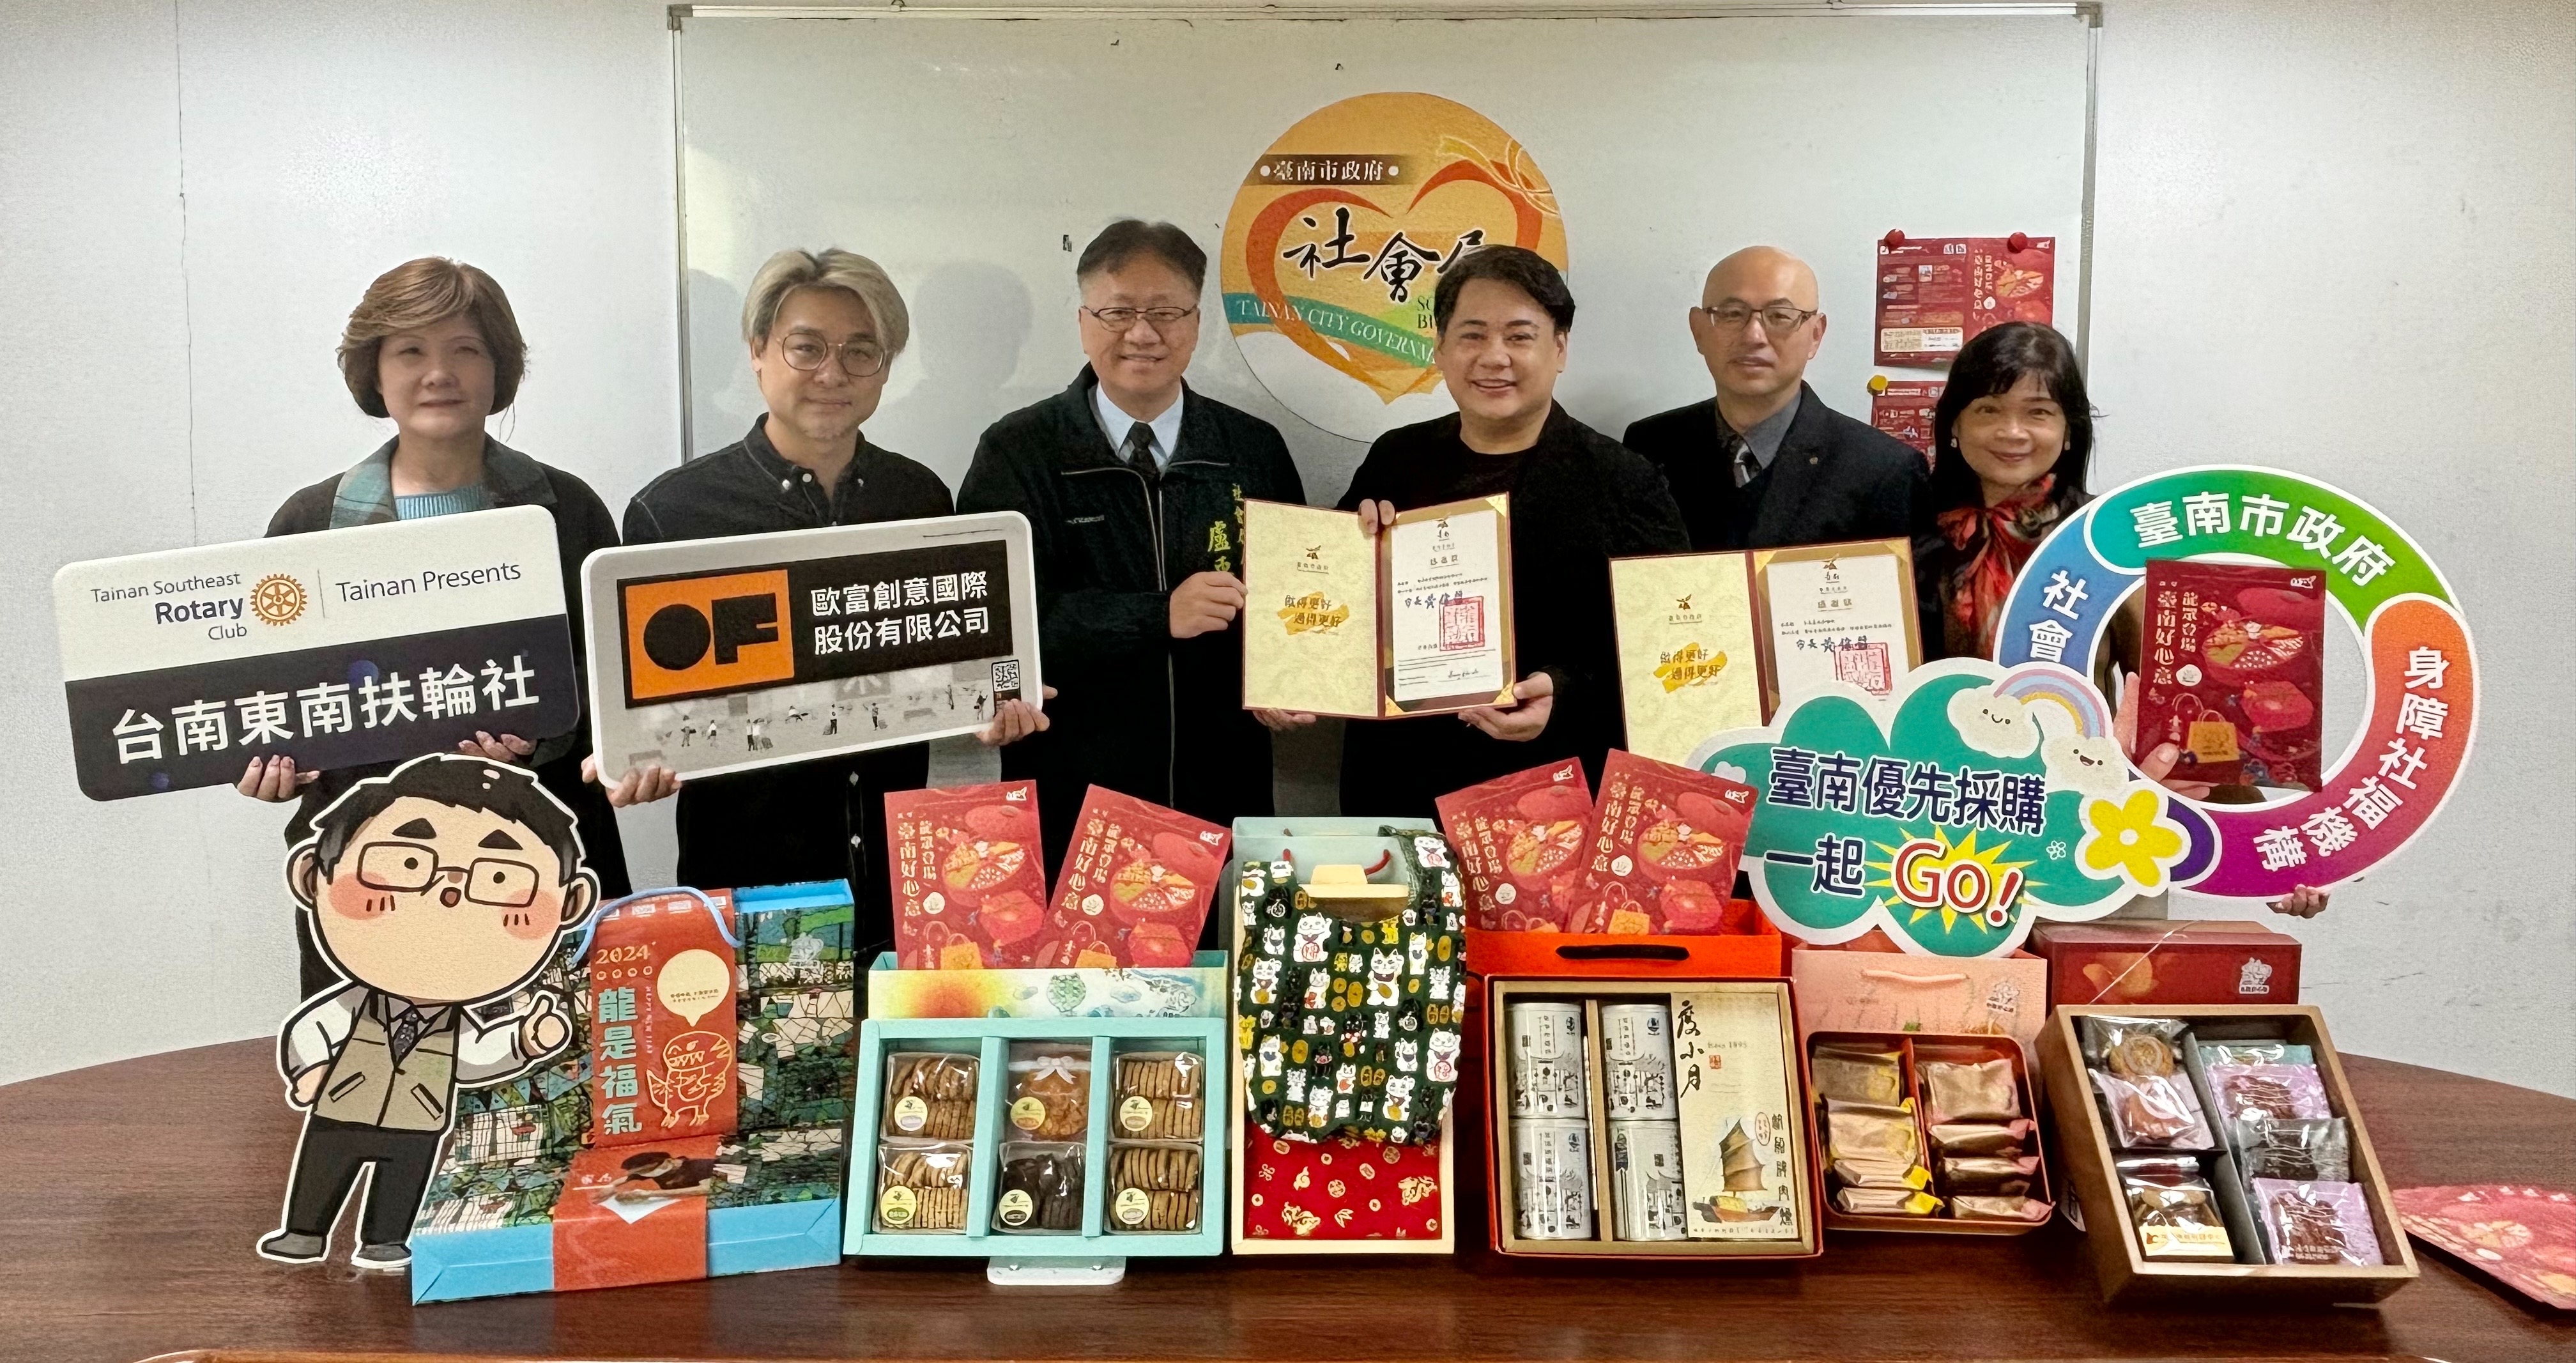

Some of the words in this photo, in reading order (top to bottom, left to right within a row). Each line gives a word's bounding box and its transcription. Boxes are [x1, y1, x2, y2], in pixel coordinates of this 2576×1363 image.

[1273, 159, 1383, 181] 臺南市政府
[1236, 300, 1305, 322] TAINAN
[1308, 309, 1349, 330] CITY
[2130, 491, 2396, 587] 臺南市政府
[91, 585, 149, 605] Tainan
[153, 572, 241, 596] Southeast
[336, 576, 416, 603] Tainan
[423, 561, 522, 592] Presents
[810, 570, 988, 617] 歐富創意國際
[155, 596, 244, 625] Rotary
[208, 623, 248, 641] Club
[643, 592, 779, 671] OF
[814, 605, 990, 656] 股份有限公司
[111, 655, 540, 766] 台南東南扶輪社
[2253, 646, 2450, 872] 身障社福機構
[1767, 746, 2046, 836] 臺南優先採購
[1764, 833, 1866, 898] 一起
[595, 944, 651, 964] 2024
[598, 986, 643, 1135] 龍是福氣
[1676, 1000, 1705, 1098] 度小月
